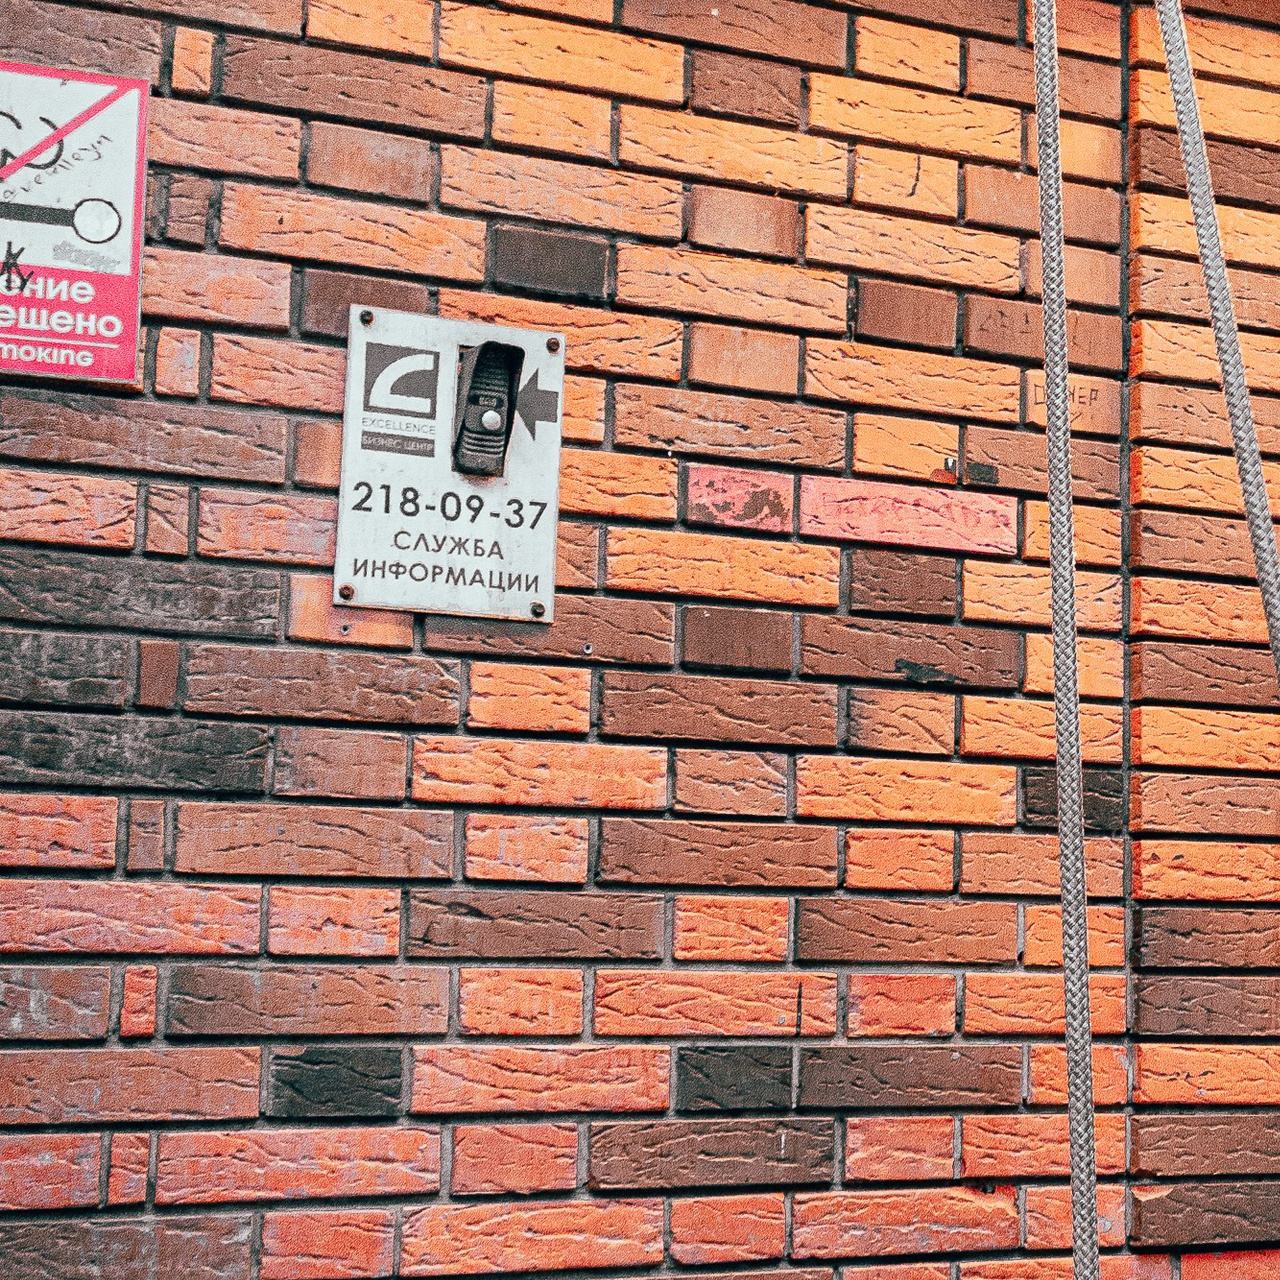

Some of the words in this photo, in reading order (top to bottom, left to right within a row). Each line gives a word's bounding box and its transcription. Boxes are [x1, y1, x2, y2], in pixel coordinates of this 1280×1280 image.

[361, 417, 436, 435] EXCELLENCE
[351, 481, 548, 530] 218-09-37
[393, 530, 505, 560] СЛУЖБА
[352, 558, 540, 594] ИНФОРМАЦИИ
